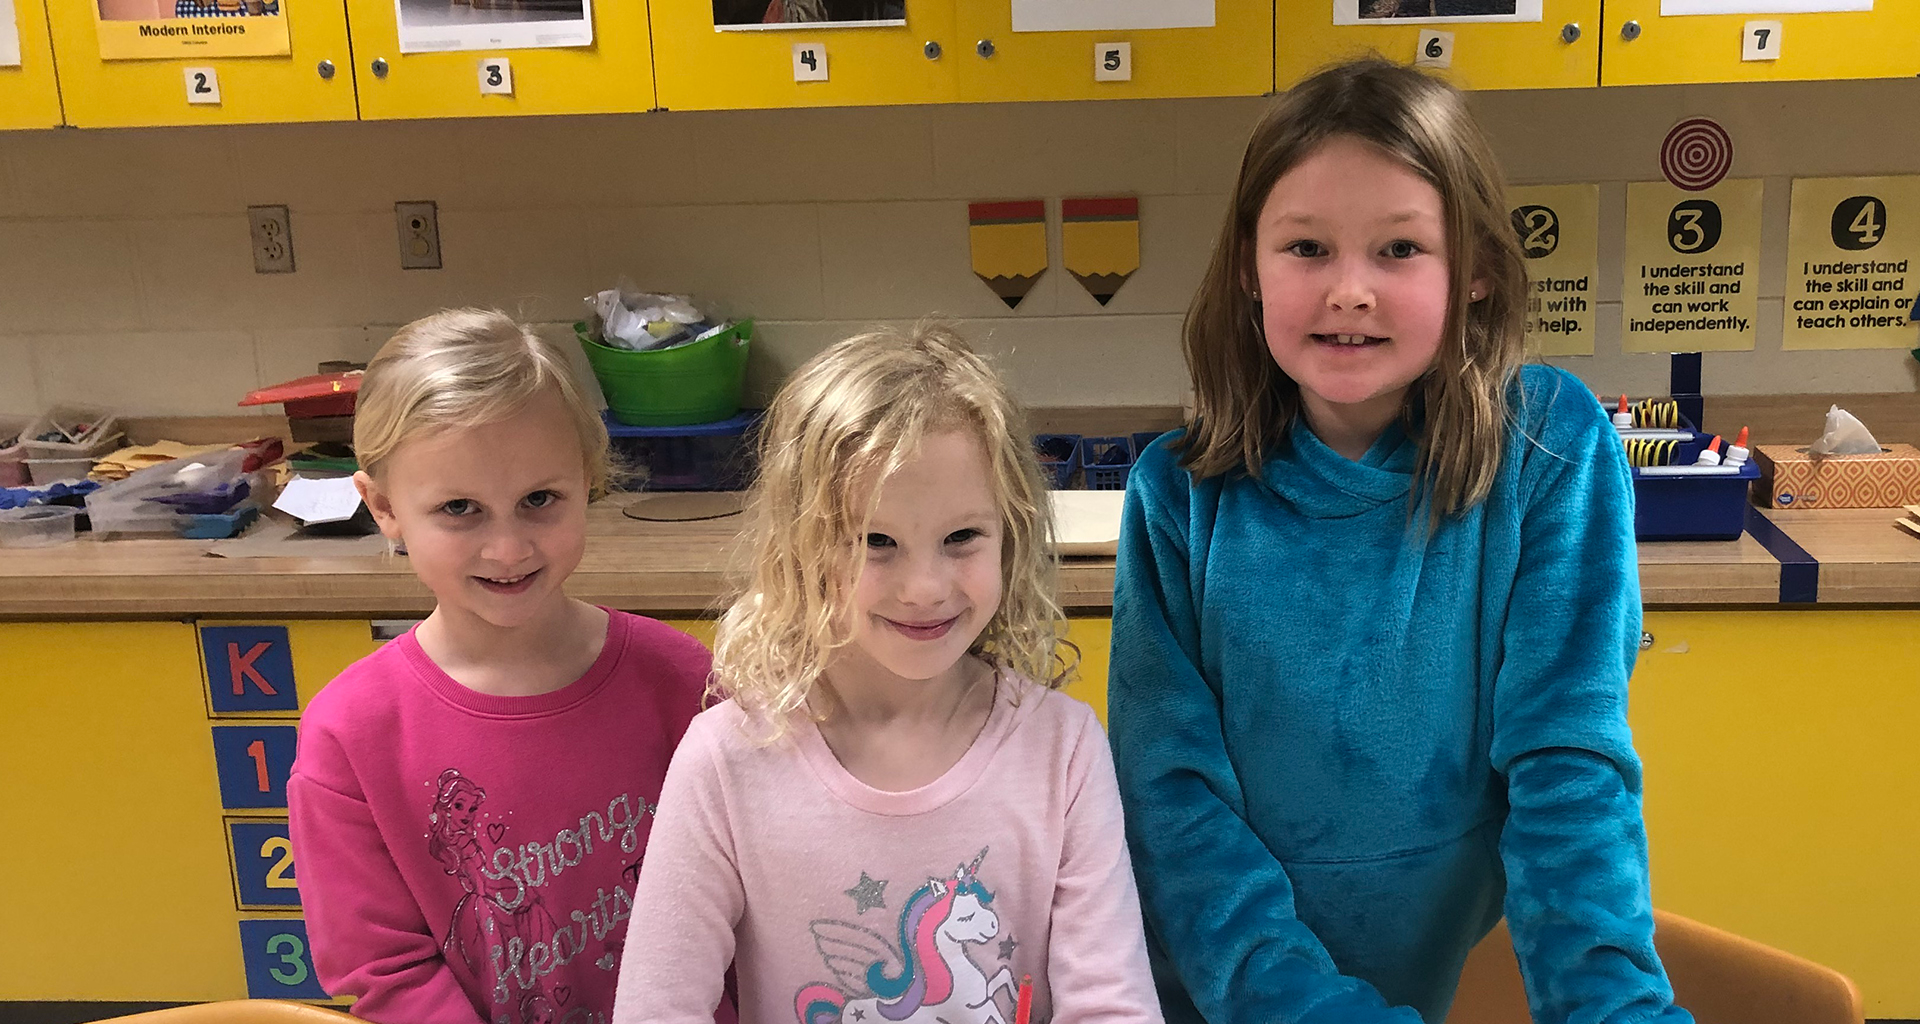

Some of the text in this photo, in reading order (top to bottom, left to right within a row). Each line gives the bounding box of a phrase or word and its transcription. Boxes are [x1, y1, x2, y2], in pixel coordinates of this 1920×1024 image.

[139, 22, 246, 37] Modern Interiors
[1753, 29, 1771, 50] 7
[1425, 37, 1443, 58] 6
[800, 49, 817, 72] 4
[1103, 49, 1121, 71] 5
[194, 72, 212, 94] 2
[486, 64, 503, 87] 3
[1524, 209, 1556, 250] 2
[1673, 209, 1705, 251] 3
[1849, 200, 1881, 243] 4
[1641, 262, 1745, 278] I understand
[1803, 259, 1908, 275] I understand
[1643, 280, 1741, 296] the skill and
[1805, 277, 1904, 293] the skill and
[1547, 296, 1587, 313] with
[1652, 298, 1729, 314] can work
[1793, 295, 1913, 313] can explain or
[1539, 317, 1582, 335] help.
[1629, 315, 1750, 334] independently.
[1796, 313, 1908, 329] teach others.
[227, 642, 277, 696] K
[247, 740, 271, 792] 1
[481, 793, 647, 909] Strong
[260, 836, 298, 889] 2
[490, 884, 634, 1004] Hearts
[266, 933, 308, 986] 3
